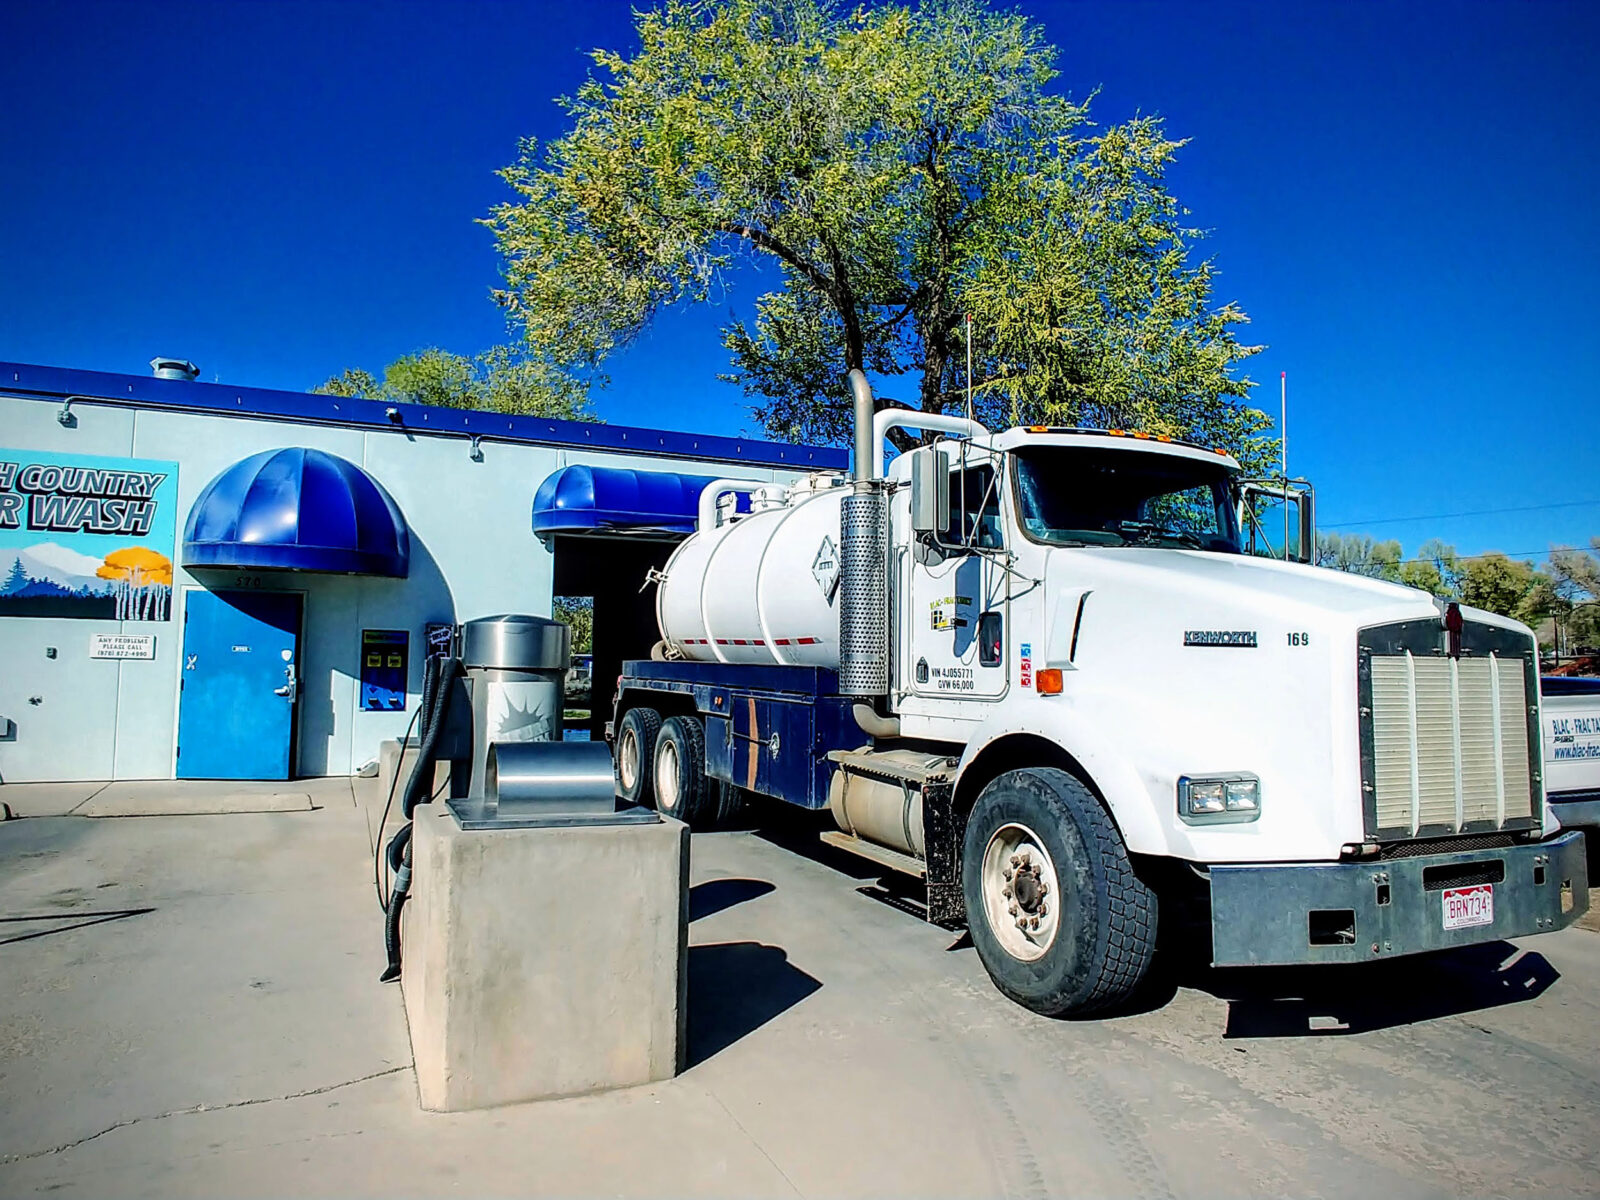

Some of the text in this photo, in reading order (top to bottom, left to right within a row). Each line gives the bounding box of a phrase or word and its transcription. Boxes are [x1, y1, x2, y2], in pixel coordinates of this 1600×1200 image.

[18, 464, 168, 499] COUNTRY
[29, 495, 158, 535] WASH
[1183, 630, 1257, 646] KENWORTH
[1286, 632, 1309, 646] 169
[931, 668, 941, 677] VIN
[938, 680, 974, 690] GVW 66,000
[1552, 719, 1570, 735] BLAC
[1449, 896, 1487, 919] BRN734
